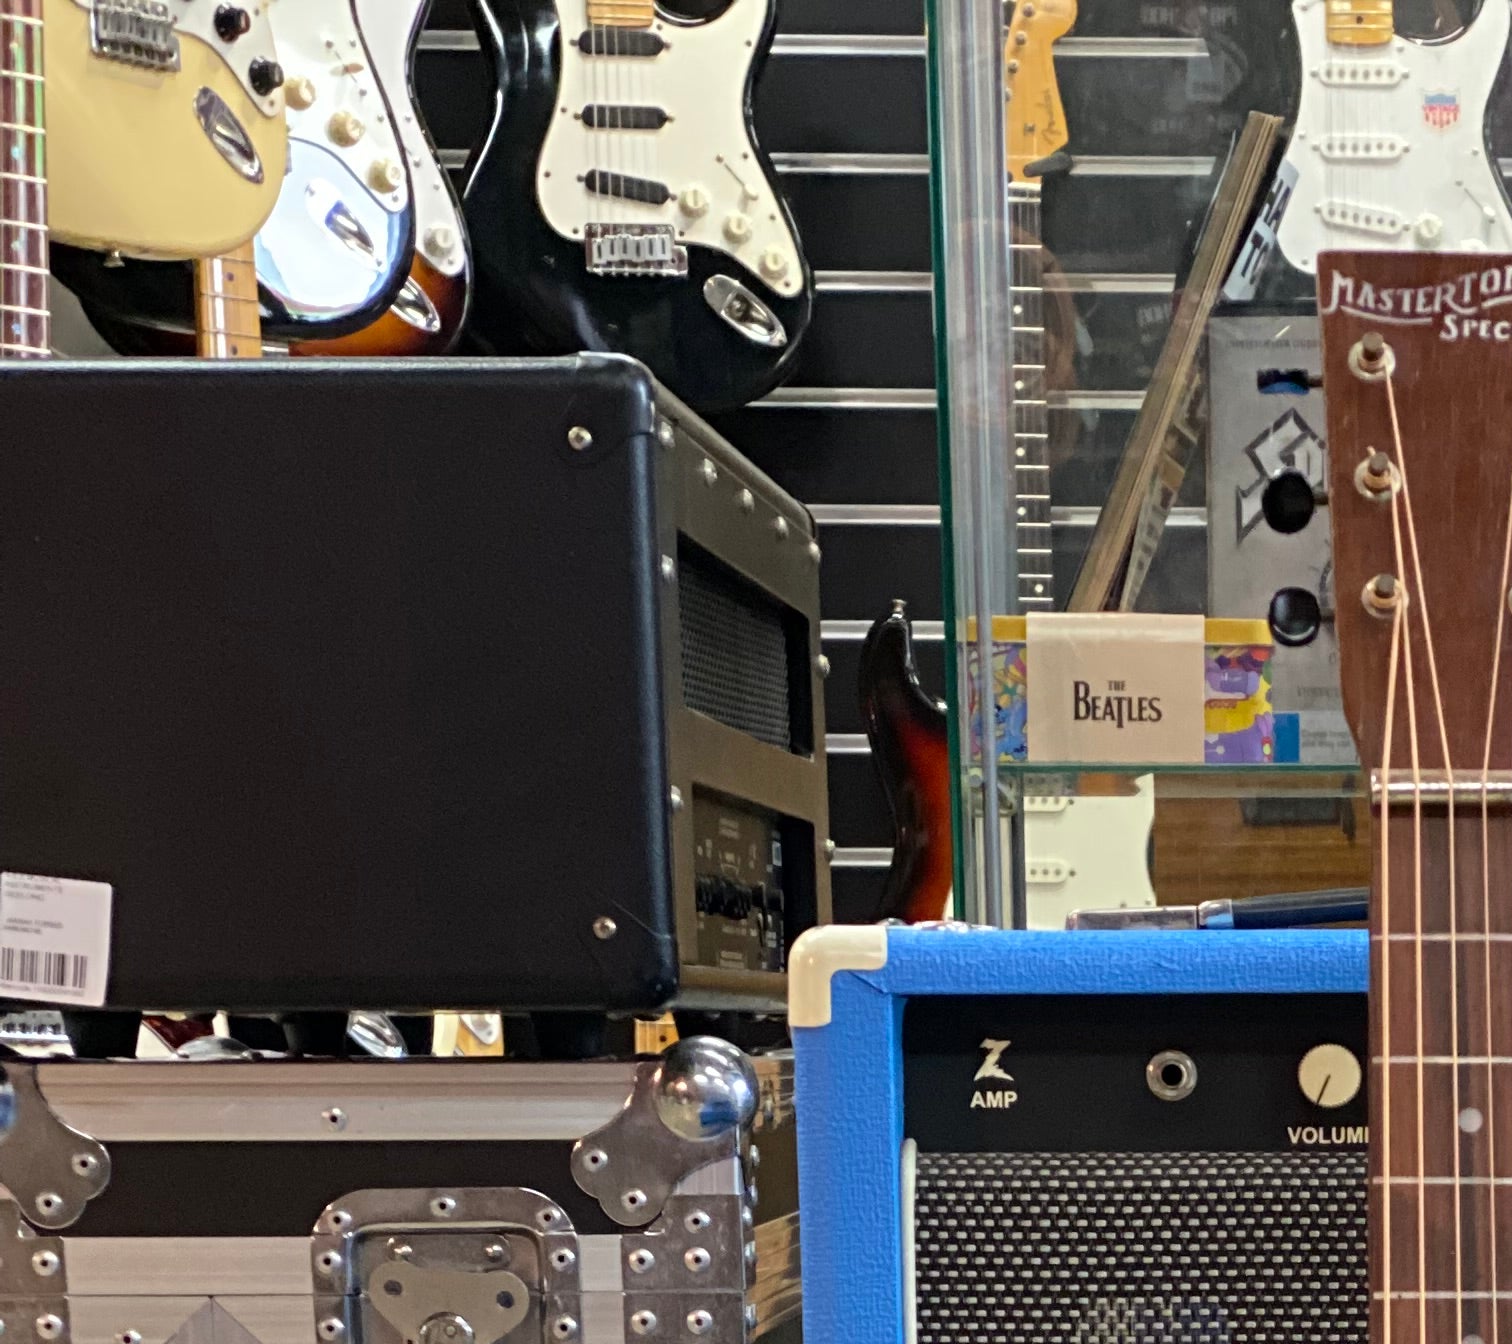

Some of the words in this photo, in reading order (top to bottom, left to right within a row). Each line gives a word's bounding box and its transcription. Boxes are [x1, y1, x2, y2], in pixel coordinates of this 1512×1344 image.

[1107, 680, 1126, 691] THE
[1073, 680, 1162, 728] BEATLES
[970, 1091, 1018, 1109] AMP
